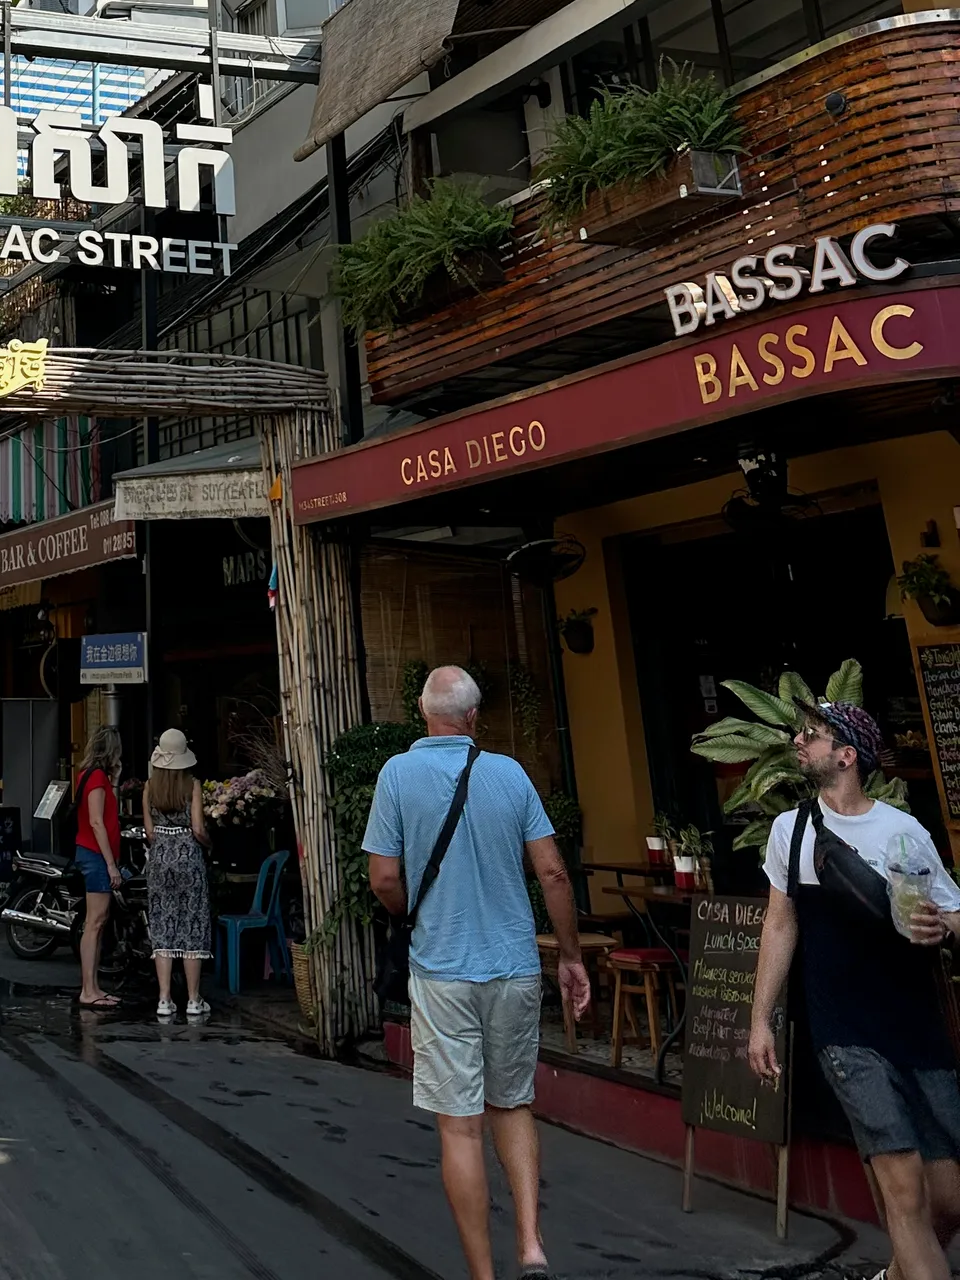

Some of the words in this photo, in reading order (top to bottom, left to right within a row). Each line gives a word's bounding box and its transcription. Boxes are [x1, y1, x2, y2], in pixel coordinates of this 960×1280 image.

[77, 229, 239, 277] STREET
[664, 222, 912, 337] BASSAC
[694, 304, 924, 405] BASSAC
[400, 446, 458, 486] CASA
[465, 420, 547, 469] DIEGO
[0, 543, 26, 574] BAR
[27, 540, 37, 568] &
[38, 524, 89, 564] COFFEE
[222, 550, 267, 588] MARS
[86, 643, 138, 663] 我在金边很想你
[697, 900, 730, 924] CASA
[704, 929, 735, 951] Lunch
[736, 931, 760, 954] Spec
